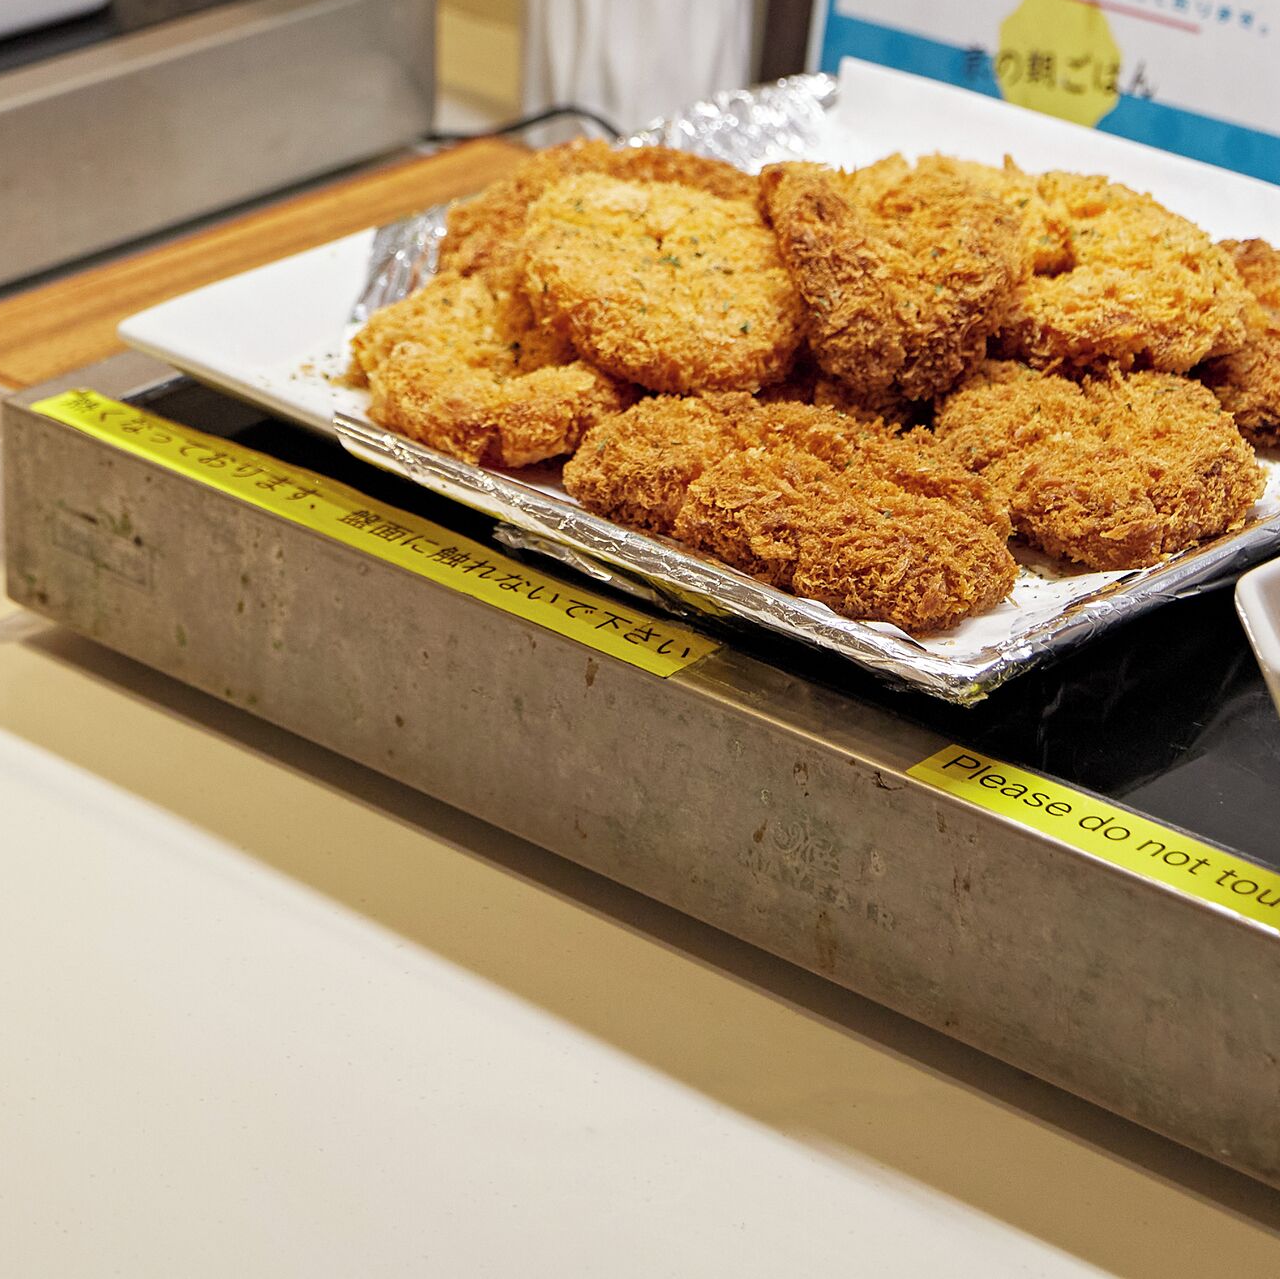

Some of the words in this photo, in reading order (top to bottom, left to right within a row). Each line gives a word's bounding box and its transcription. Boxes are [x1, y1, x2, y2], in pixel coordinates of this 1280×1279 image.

[942, 752, 1073, 819] Please
[1077, 815, 1131, 842] do
[1135, 835, 1211, 876] not
